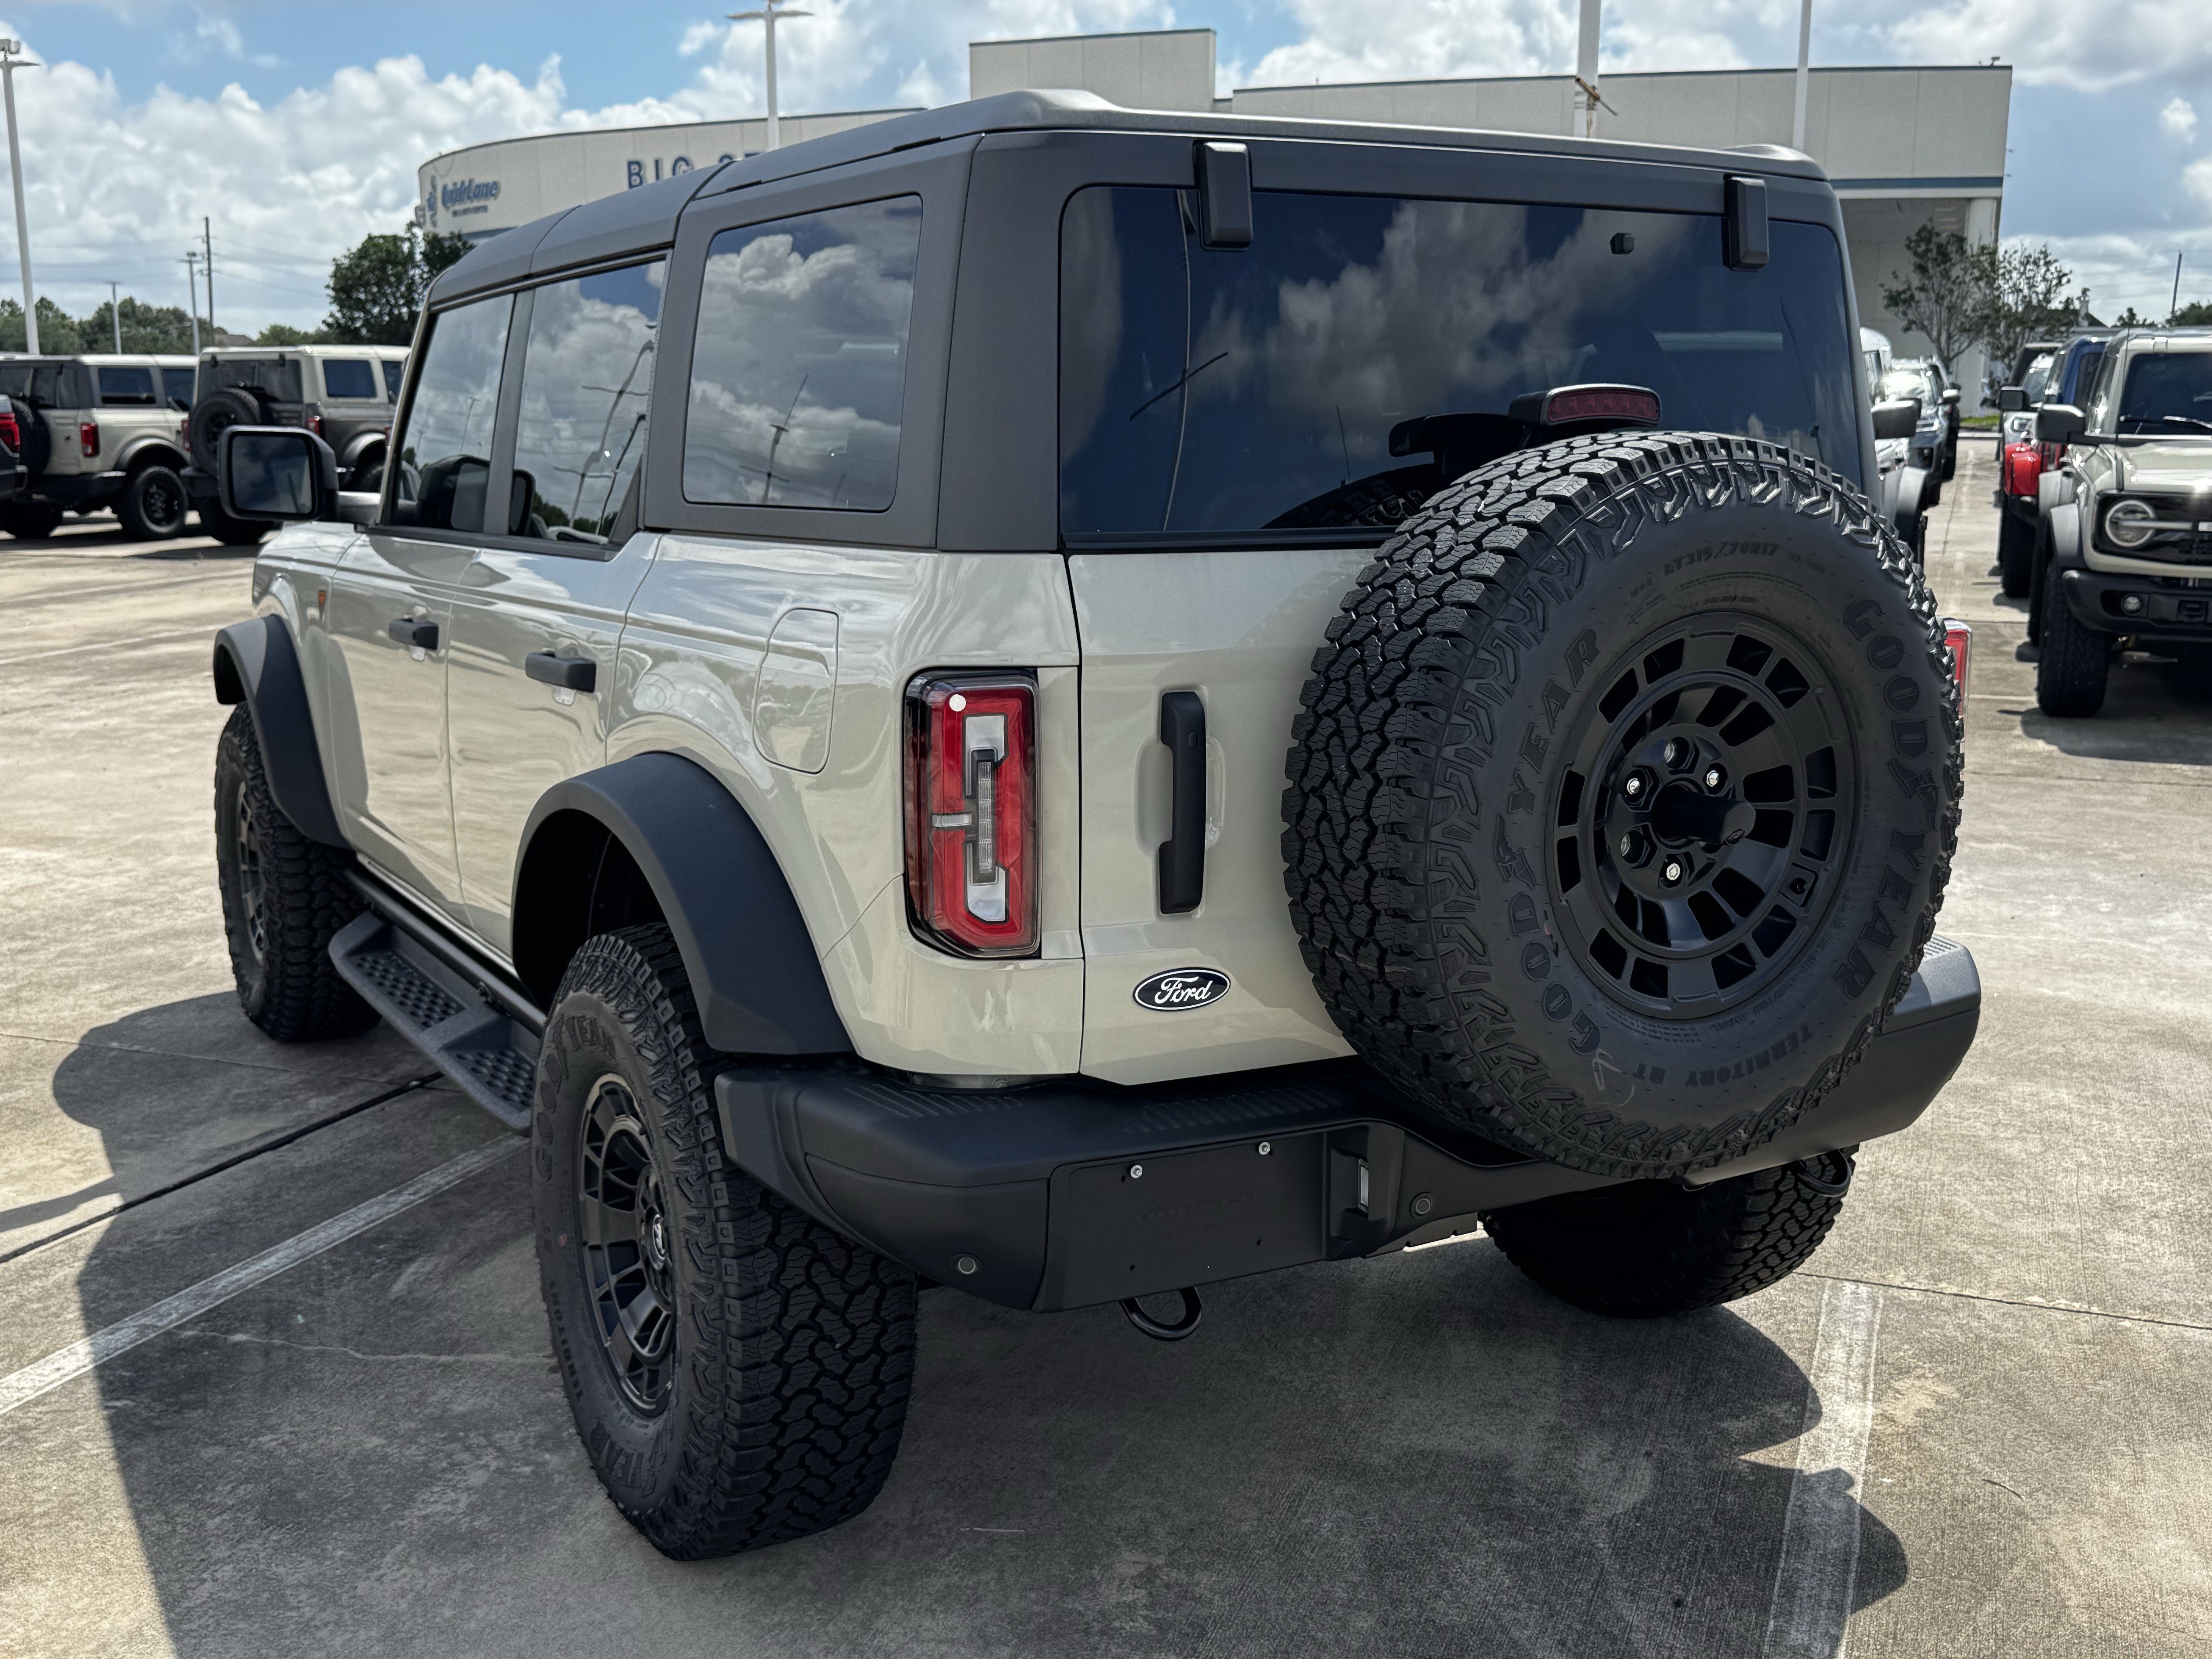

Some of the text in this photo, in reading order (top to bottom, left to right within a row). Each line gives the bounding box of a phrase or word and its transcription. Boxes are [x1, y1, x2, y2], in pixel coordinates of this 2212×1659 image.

[627, 156, 694, 189] BIG
[1154, 976, 1213, 1004] Ford
[1632, 1022, 1814, 1087] TERRITORY RT
